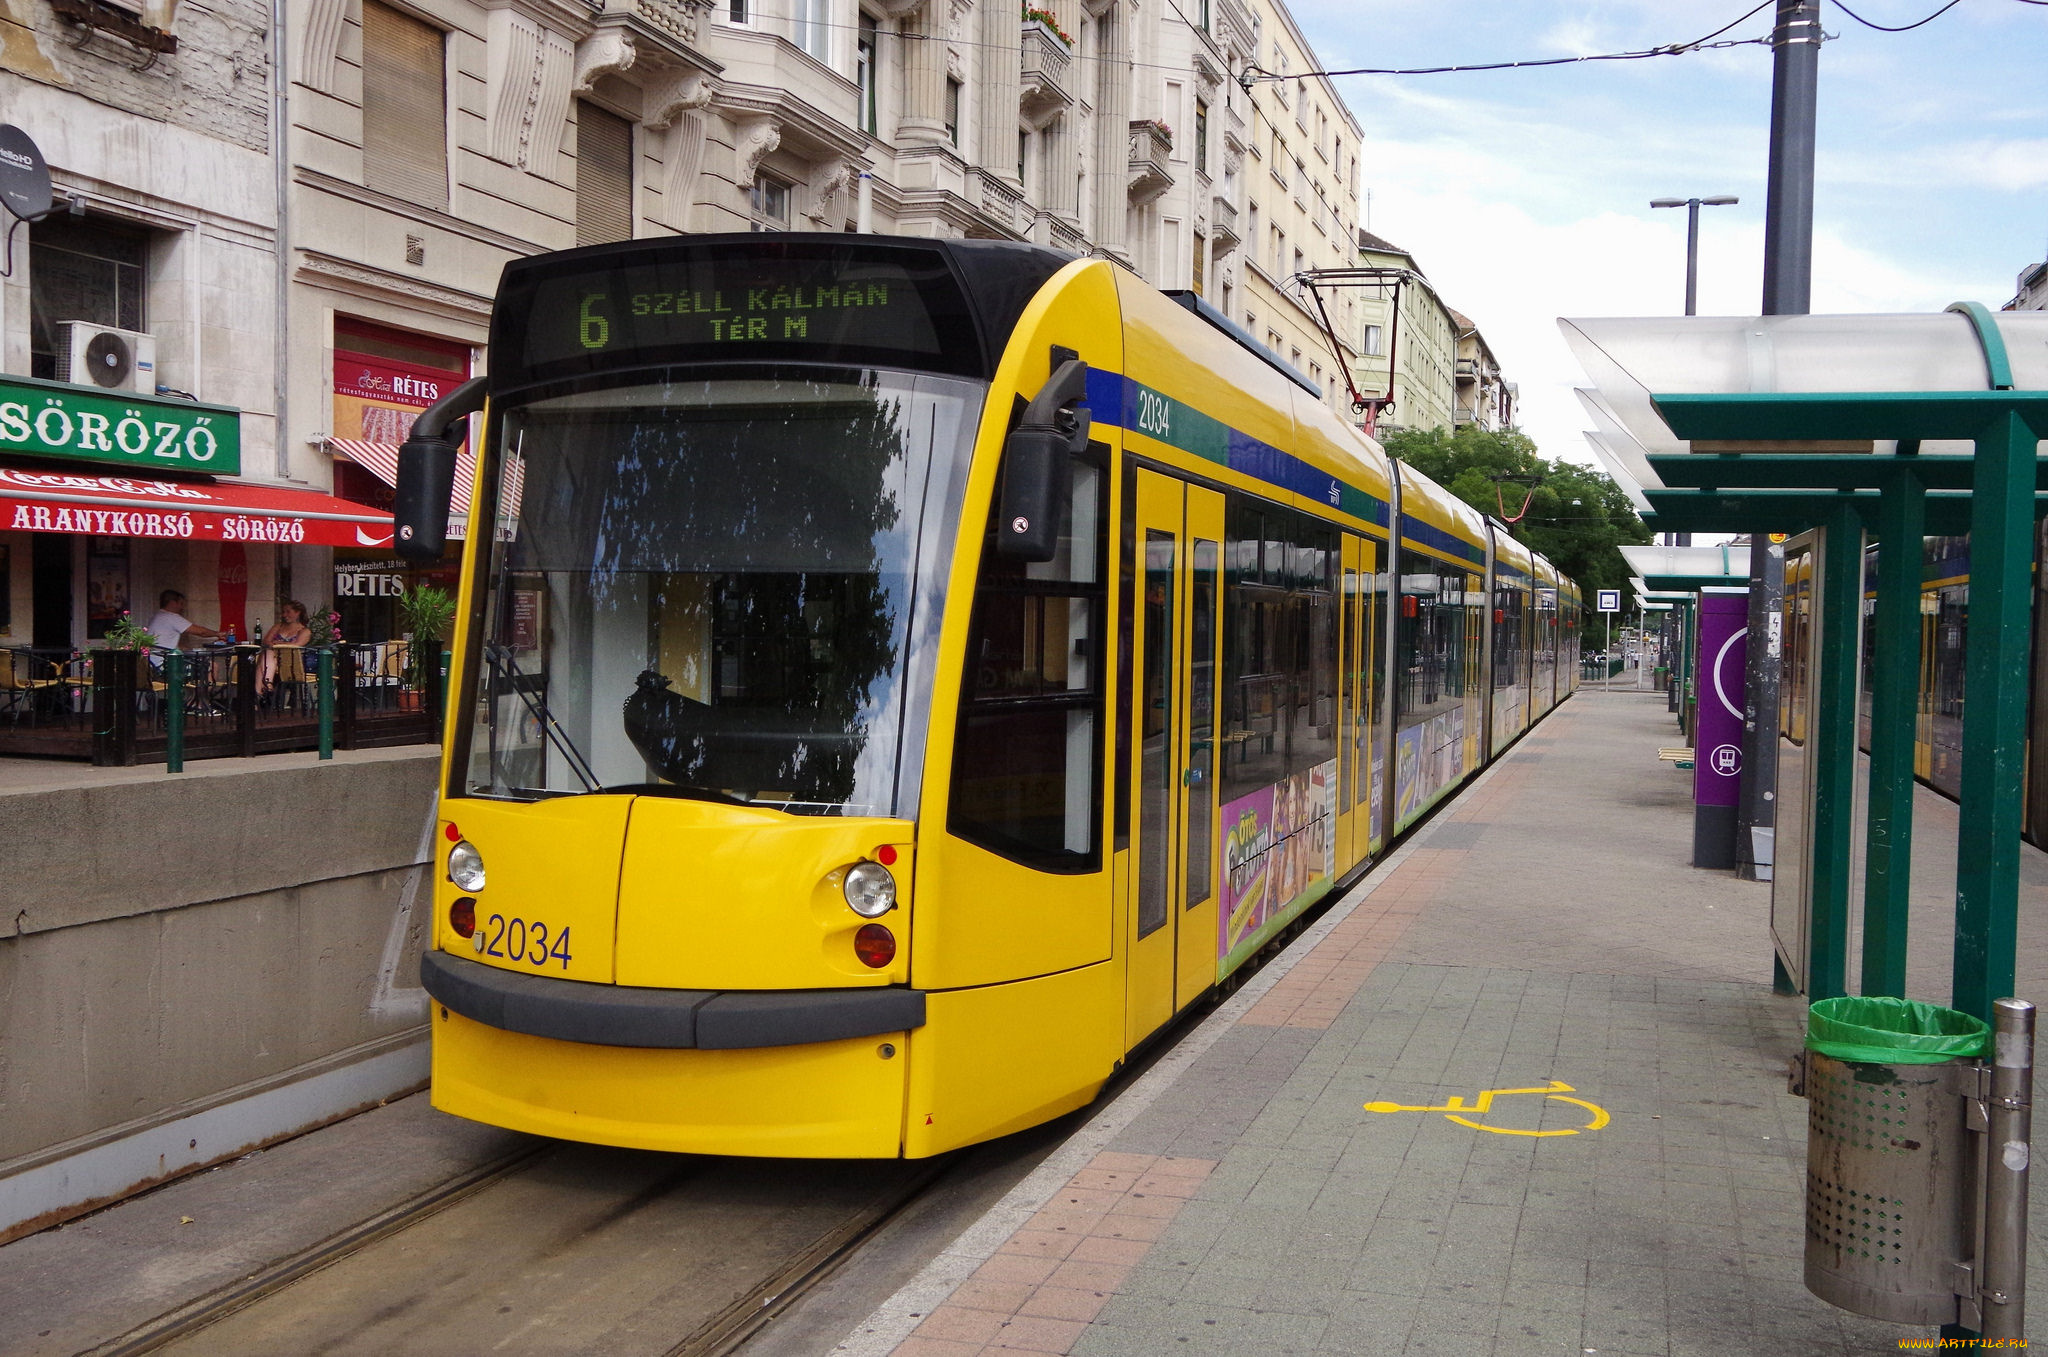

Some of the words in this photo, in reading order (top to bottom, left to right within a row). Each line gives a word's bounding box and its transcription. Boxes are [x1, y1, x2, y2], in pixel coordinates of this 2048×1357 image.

[632, 290, 731, 315] SZÉLL
[749, 283, 887, 310] KÁLMÁN
[580, 293, 608, 348] 6
[710, 316, 767, 340] TÉR
[784, 316, 807, 339] M
[393, 375, 438, 400] RÉTES
[0, 398, 218, 461] SÖRÖZŐ
[1139, 390, 1169, 437] 2034
[11, 505, 194, 537] ARANYKORSÓ
[222, 514, 304, 543] SÖRÖZŐ
[487, 914, 572, 970] 2034
